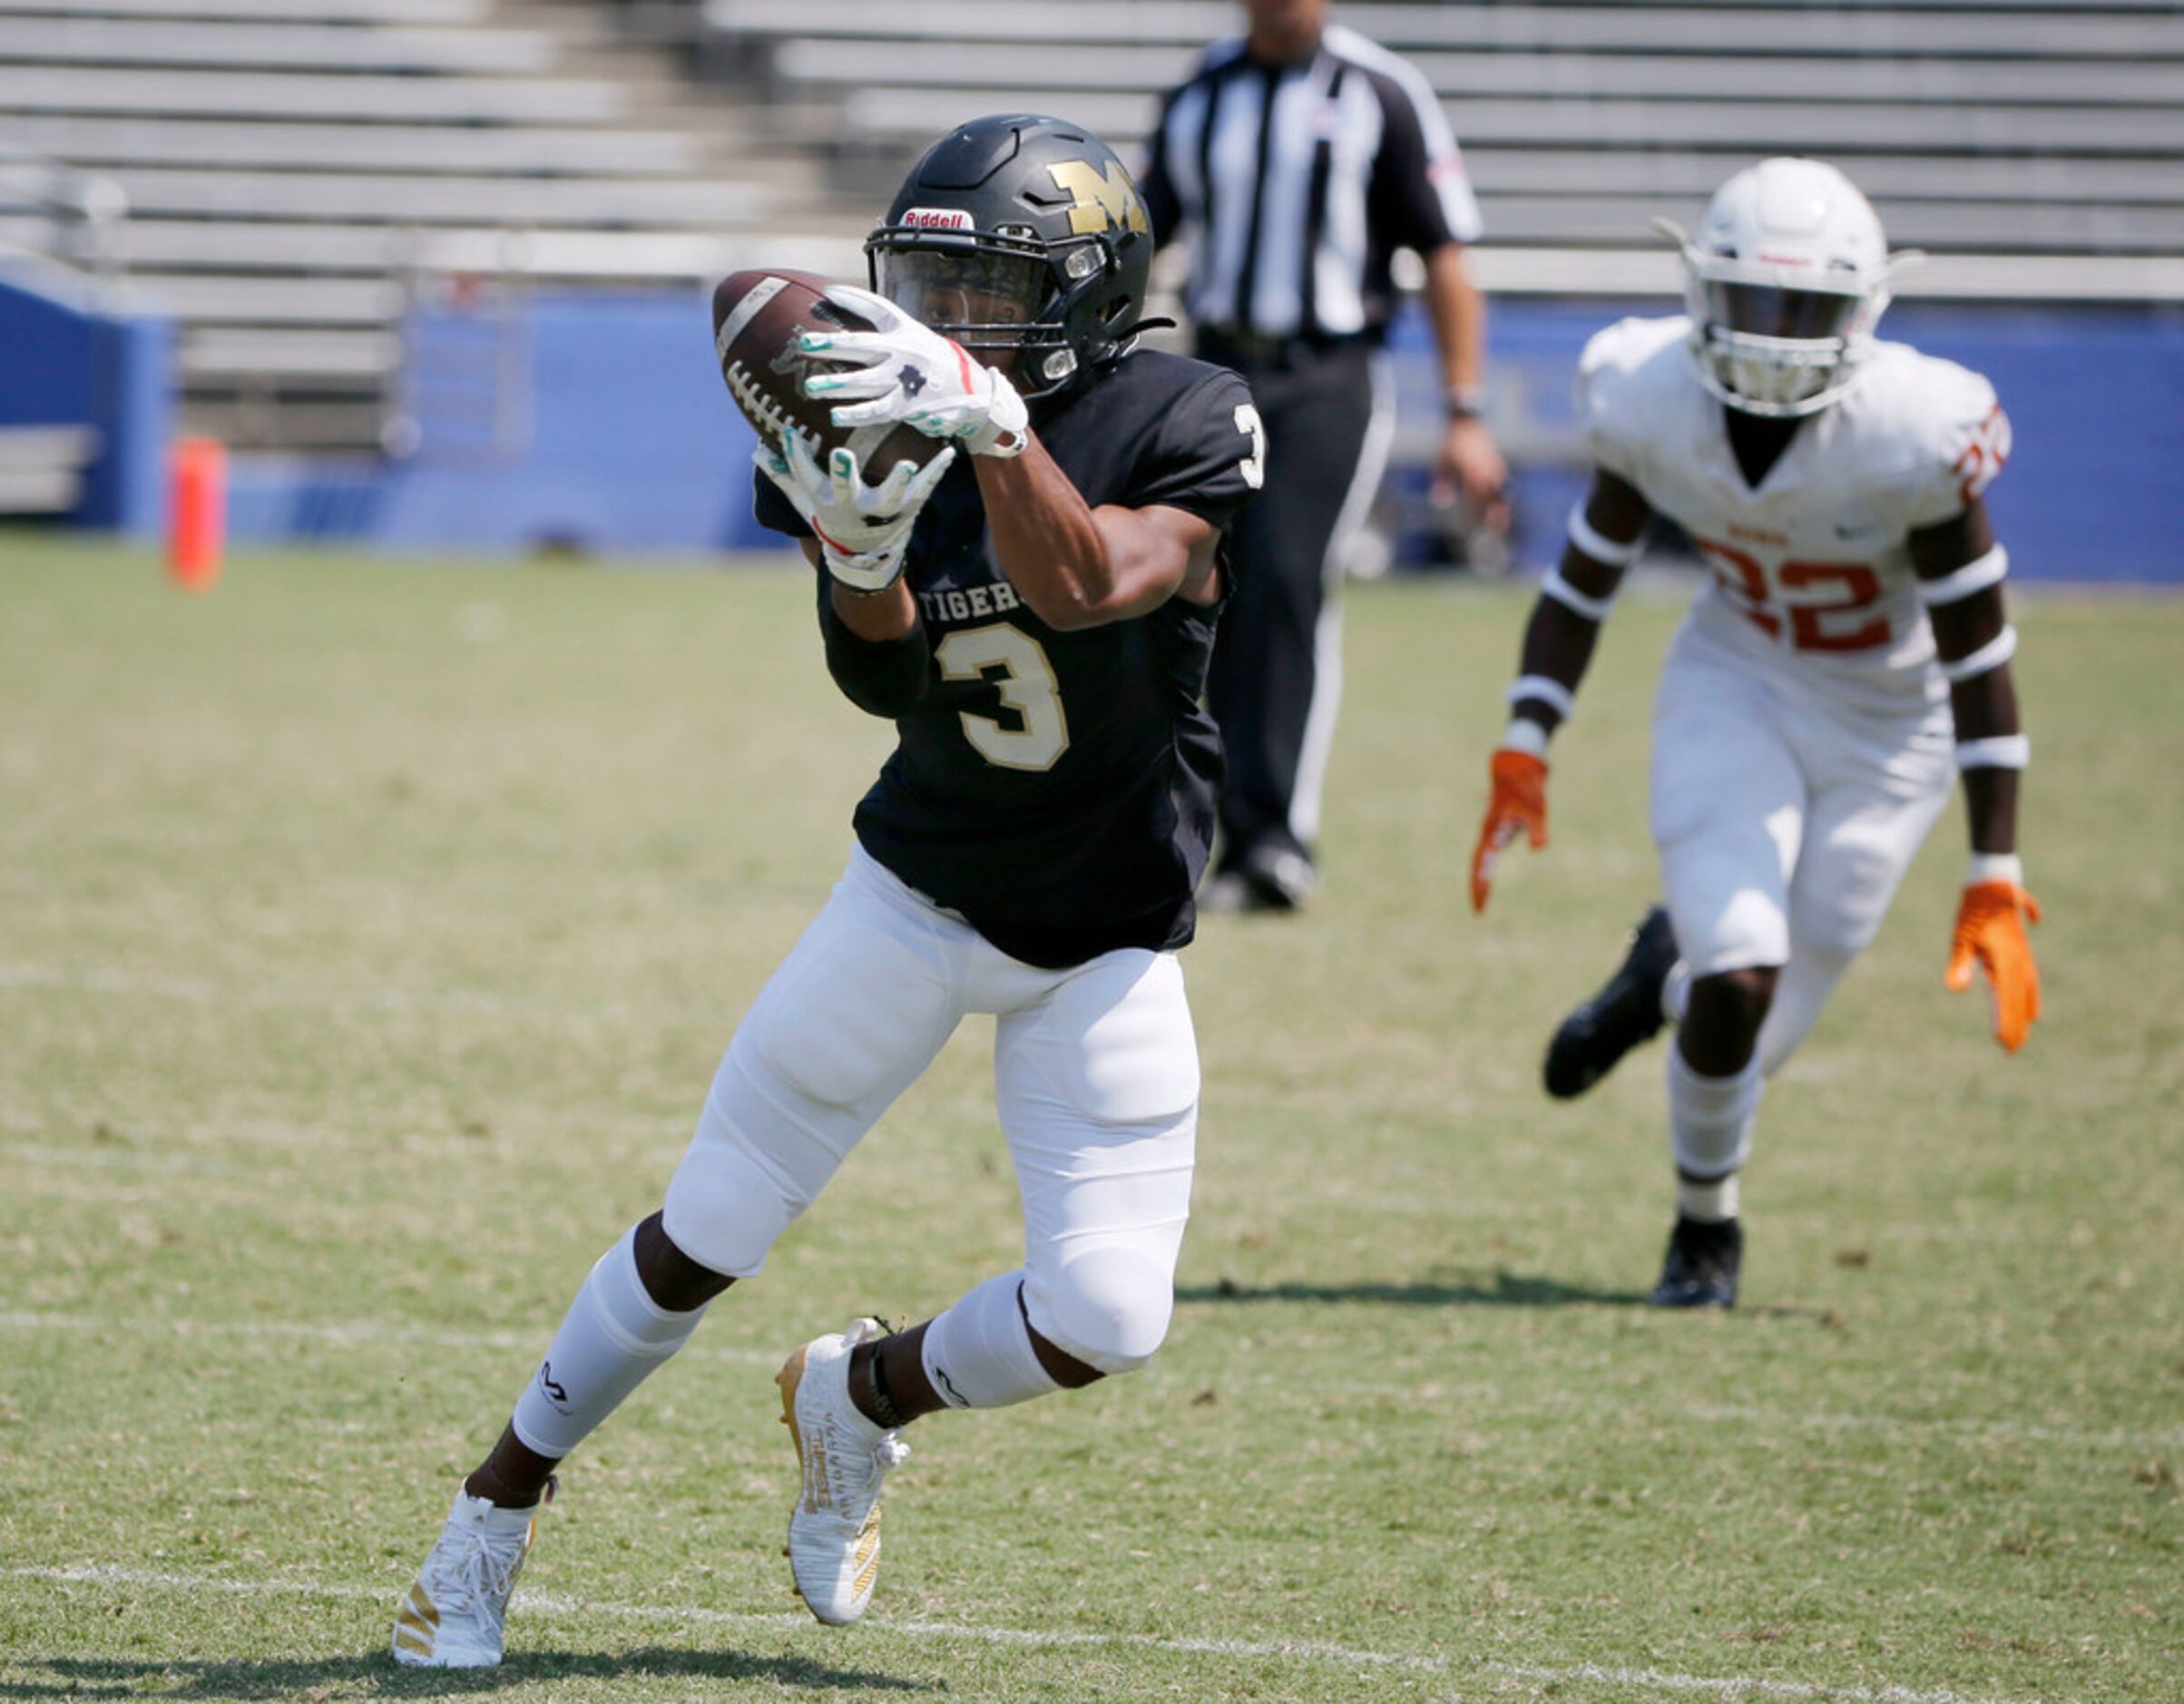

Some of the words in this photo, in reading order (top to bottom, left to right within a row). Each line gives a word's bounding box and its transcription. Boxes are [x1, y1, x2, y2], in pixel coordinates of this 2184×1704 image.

[906, 212, 963, 229] Riddell
[1046, 159, 1149, 234] M
[1233, 404, 1268, 490] 3
[917, 581, 1023, 622] TIGER
[933, 621, 1072, 772] 3
